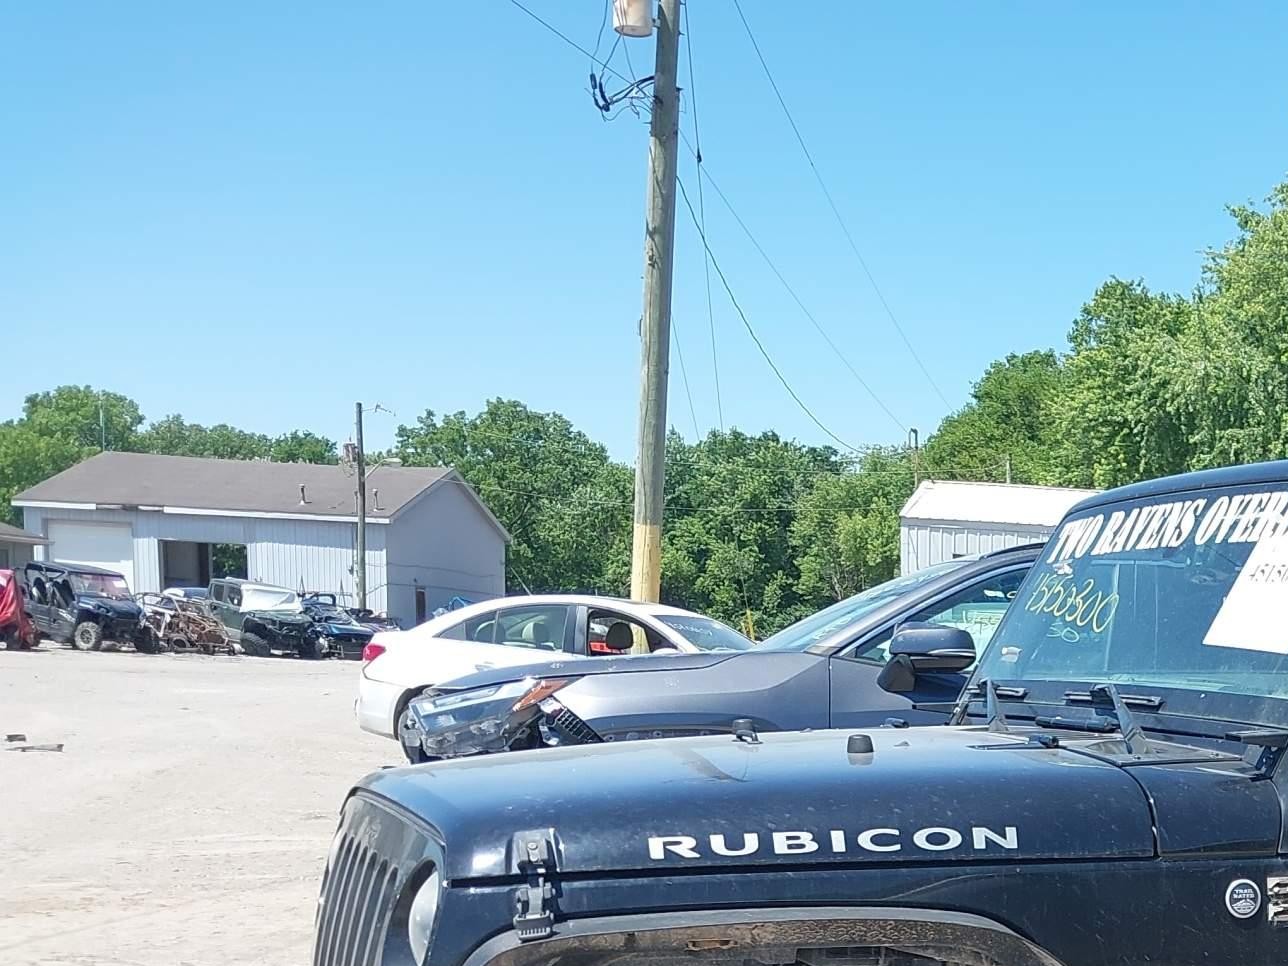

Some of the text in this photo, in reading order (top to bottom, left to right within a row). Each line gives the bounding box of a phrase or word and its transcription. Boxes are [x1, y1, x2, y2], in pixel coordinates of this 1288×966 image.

[1047, 515, 1103, 563] TWO
[1095, 499, 1206, 555] RAVENS
[648, 827, 1018, 859] RUBICON
